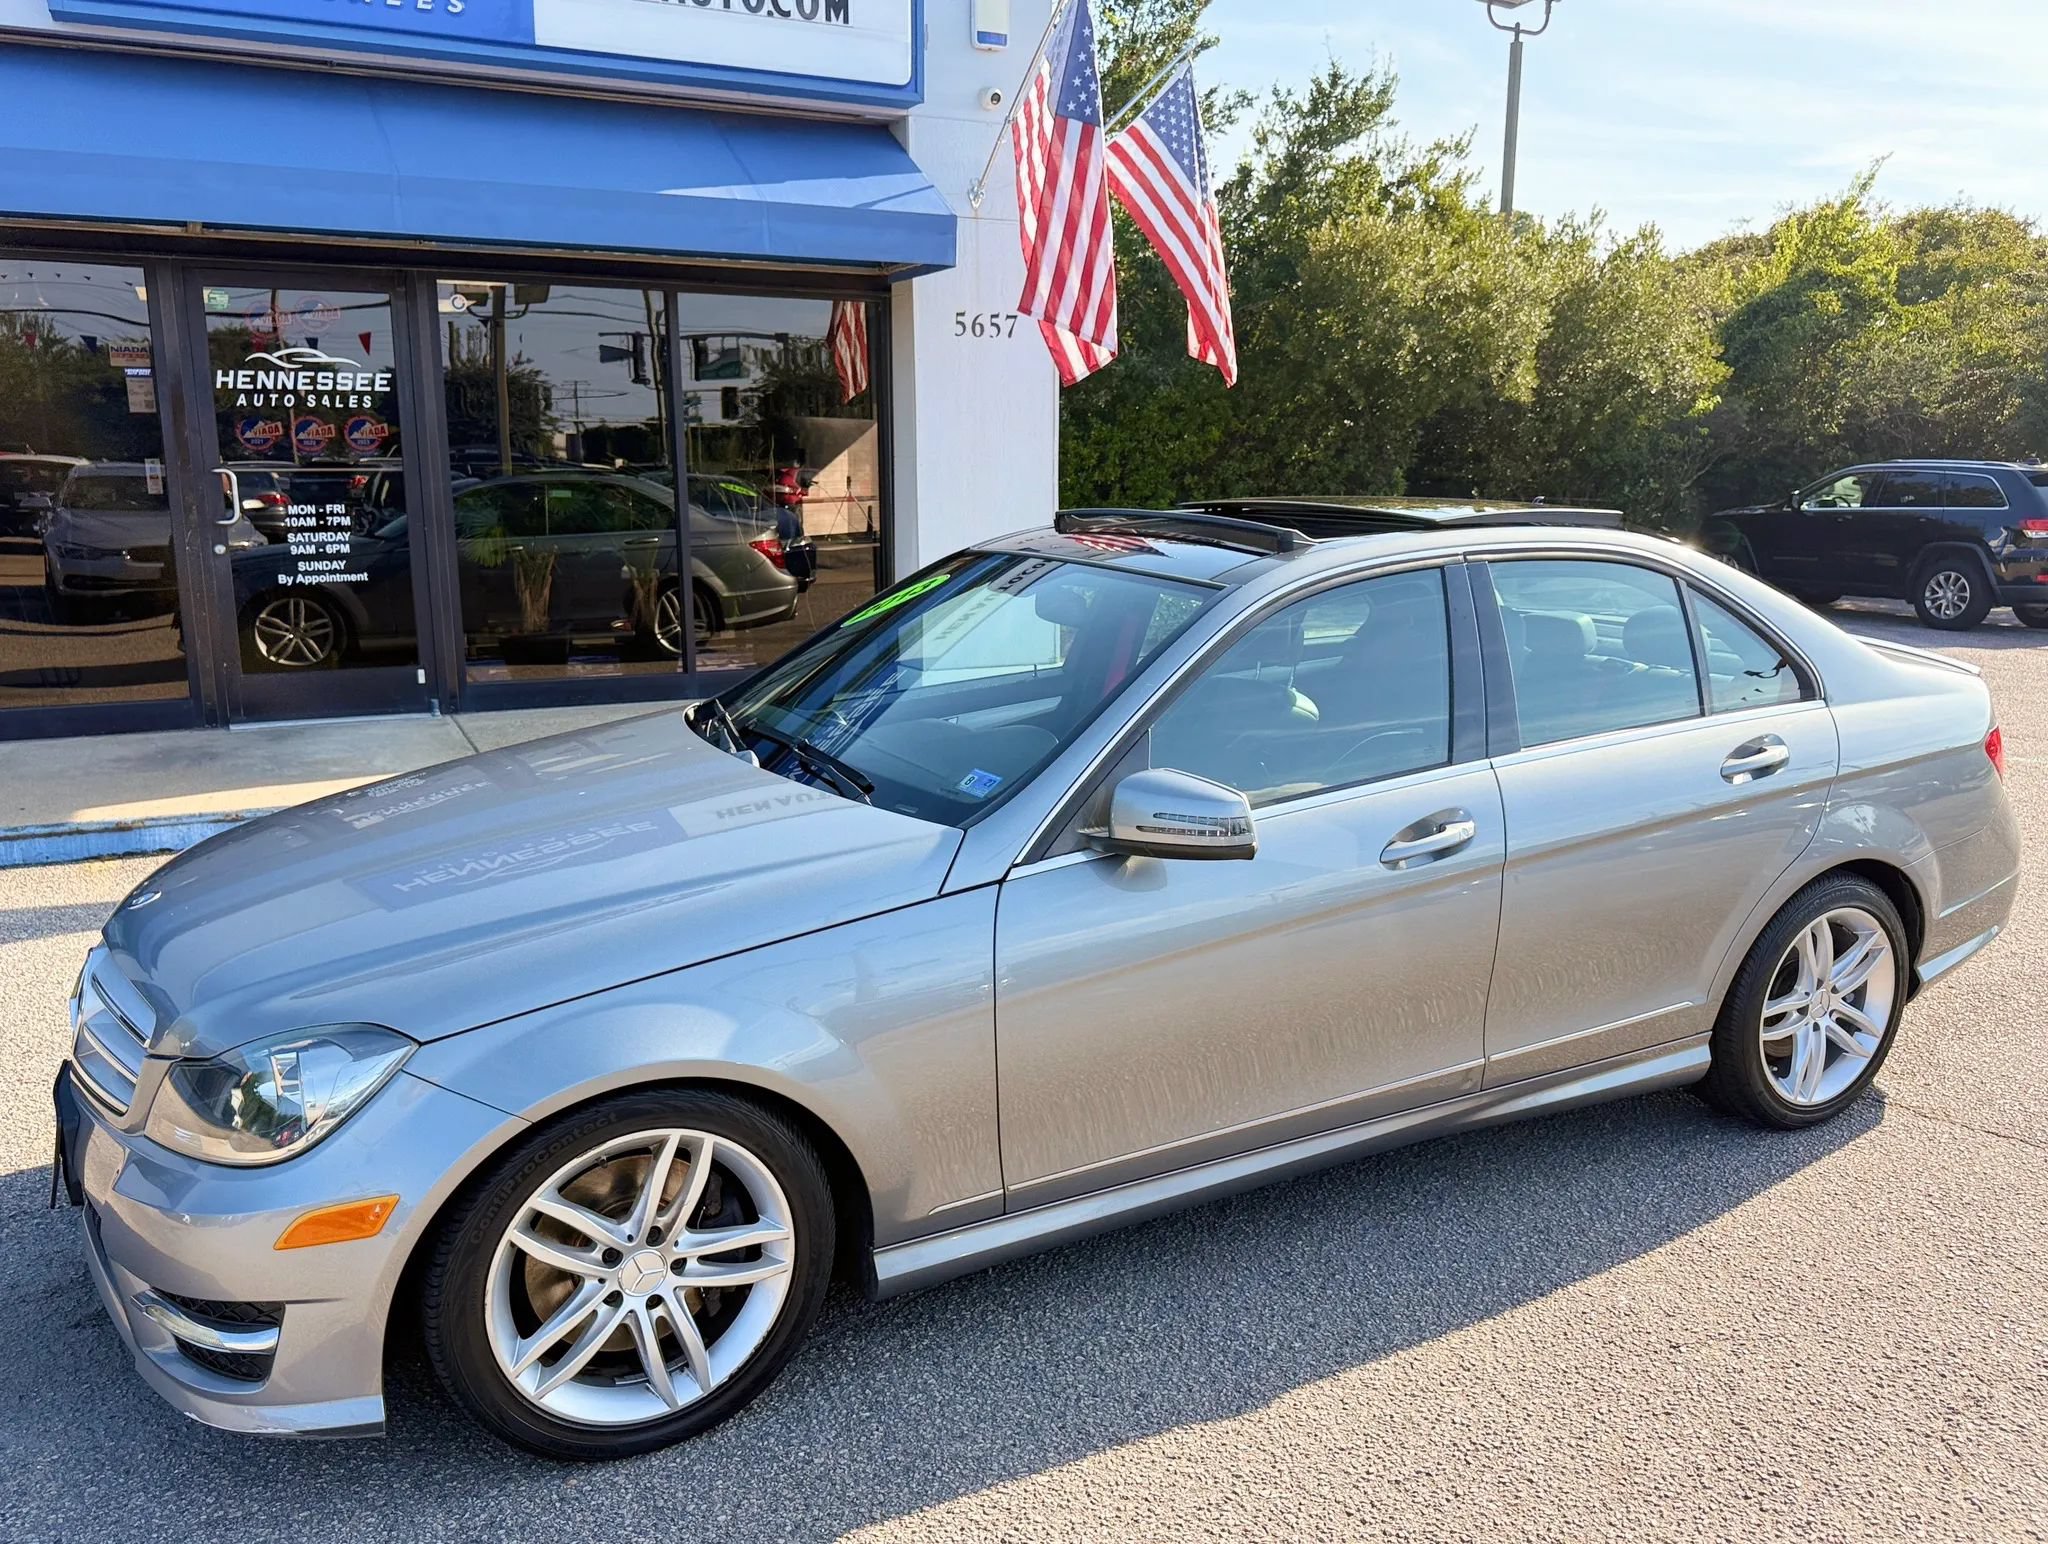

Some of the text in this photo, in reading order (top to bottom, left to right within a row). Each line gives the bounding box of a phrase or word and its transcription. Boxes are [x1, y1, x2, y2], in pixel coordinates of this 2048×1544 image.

[661, 0, 850, 25] .COM
[954, 311, 1018, 339] 5657
[216, 370, 392, 392] HENNESSEE
[236, 394, 373, 409] AUTO SALES
[287, 504, 316, 515] MON
[326, 504, 346, 515] FRI
[284, 517, 317, 528] 10AM
[326, 516, 352, 527] 7PM
[287, 531, 352, 544] SATURDAY
[290, 545, 317, 556] 9AM
[325, 544, 351, 555] 6PM
[297, 560, 347, 572] SUNDAY
[277, 572, 369, 587] By Appointment
[469, 1111, 617, 1244] ContiProContact
